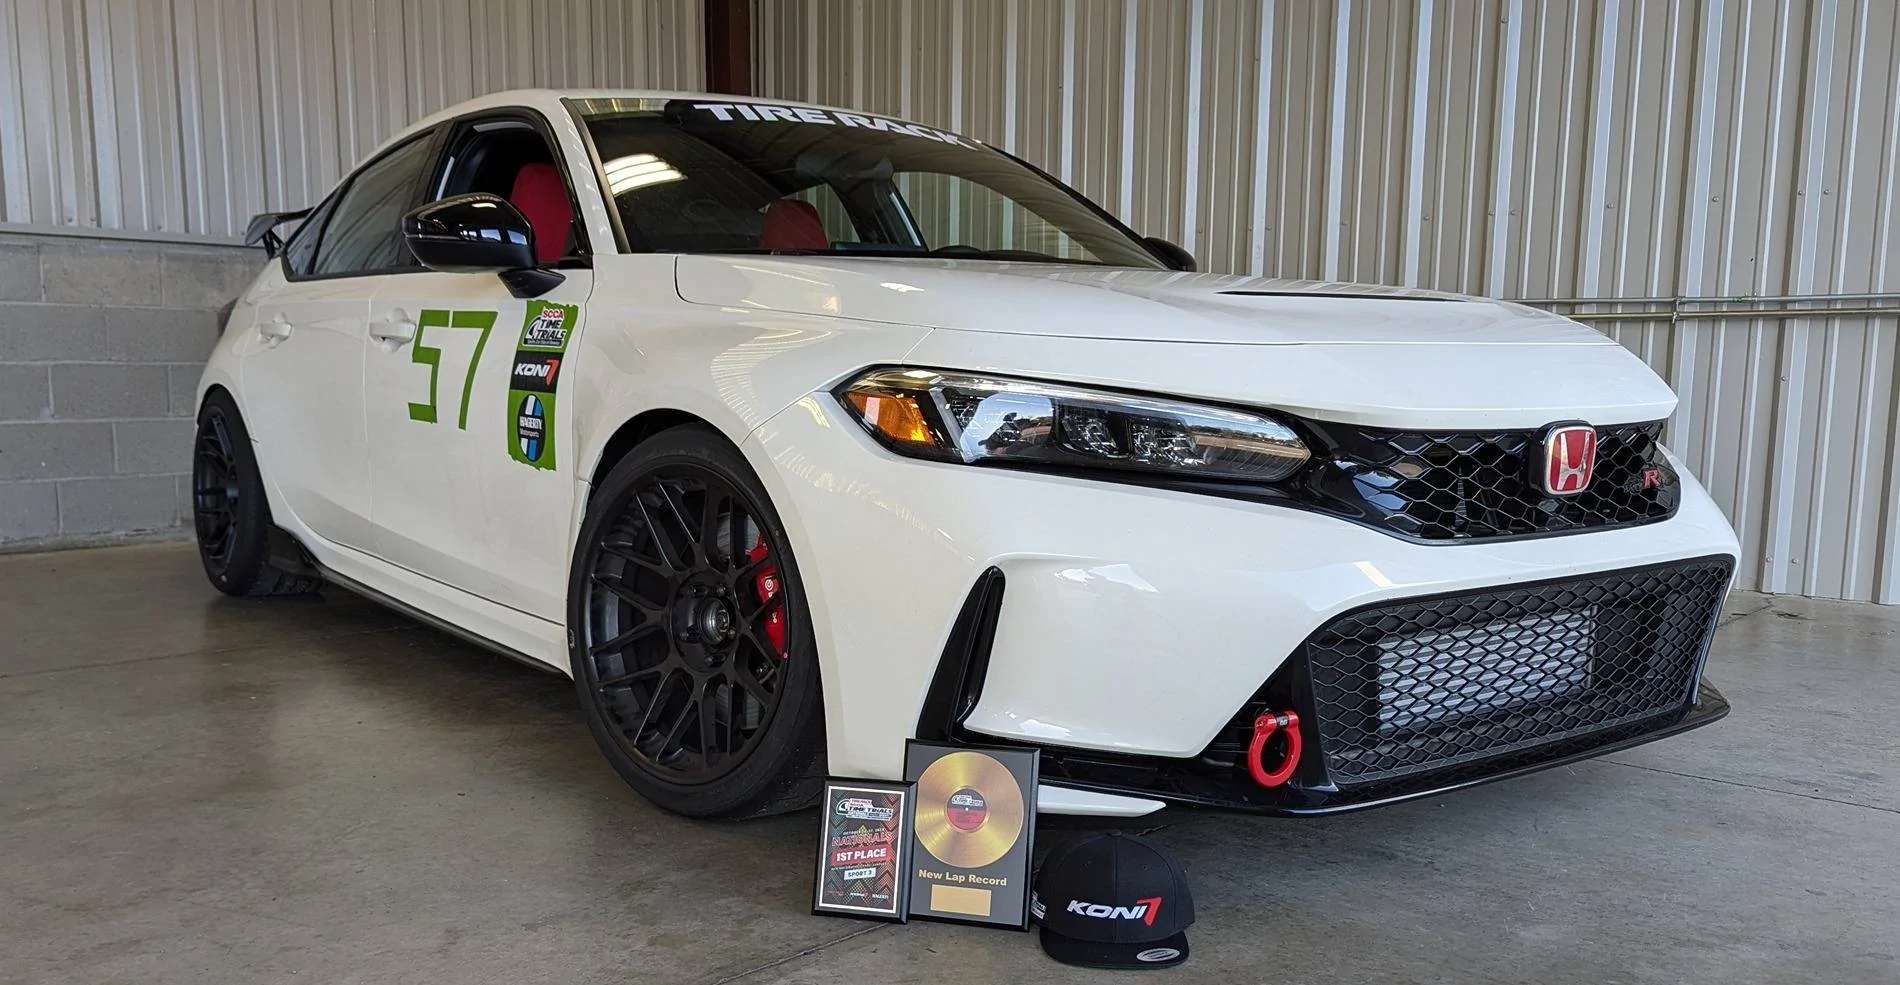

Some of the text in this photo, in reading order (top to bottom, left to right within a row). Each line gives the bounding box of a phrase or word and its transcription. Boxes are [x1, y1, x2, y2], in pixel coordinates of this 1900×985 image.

[694, 104, 978, 151] TIRE RACK
[543, 310, 564, 319] SCCA
[541, 319, 563, 329] TIME
[537, 329, 566, 340] TRIALS
[407, 309, 499, 432] 57
[514, 362, 551, 378] KONI
[519, 416, 543, 430] HAGERTY
[836, 848, 887, 862] 1ST PLACE
[847, 870, 867, 878] SPORT
[918, 869, 1008, 887] New Lap Record
[1066, 900, 1148, 920] KONI
